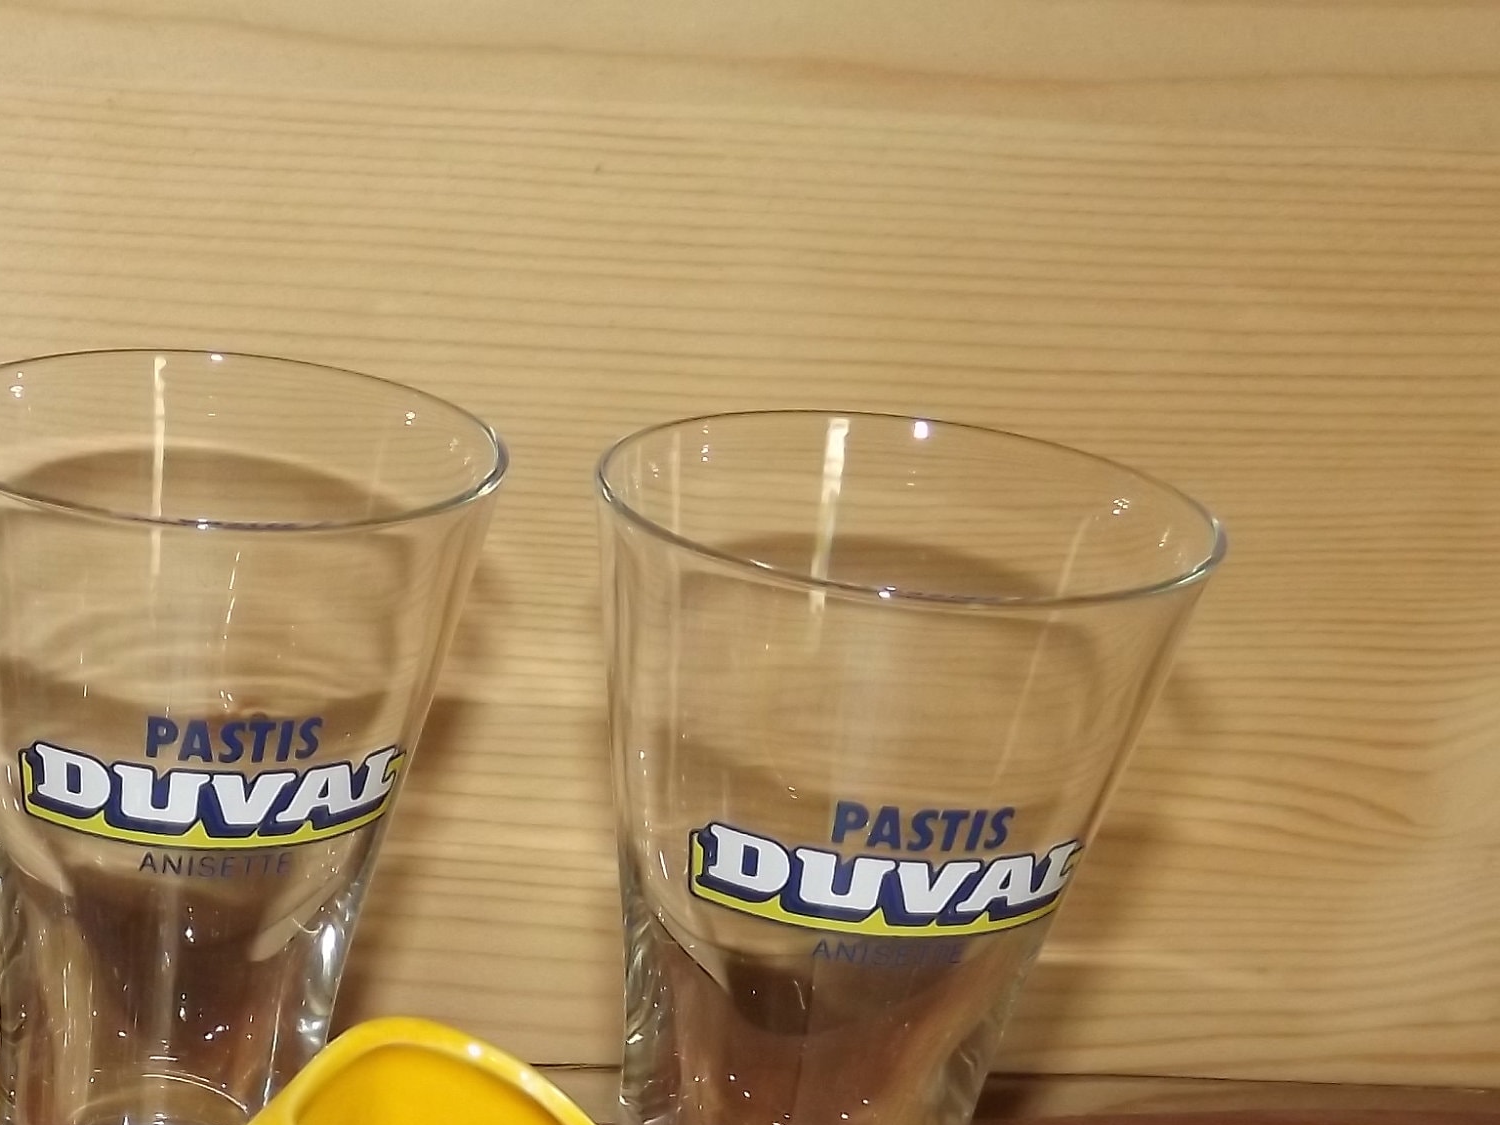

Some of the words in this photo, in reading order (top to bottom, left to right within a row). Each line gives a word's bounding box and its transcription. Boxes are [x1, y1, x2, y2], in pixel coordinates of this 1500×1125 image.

[145, 715, 324, 763] PASTIS
[21, 741, 405, 842] DUVAL
[830, 801, 1016, 852] PASTIS
[138, 851, 294, 878] ANISETTE
[689, 823, 1083, 932] DUVAL
[811, 937, 962, 965] ANISETTE
